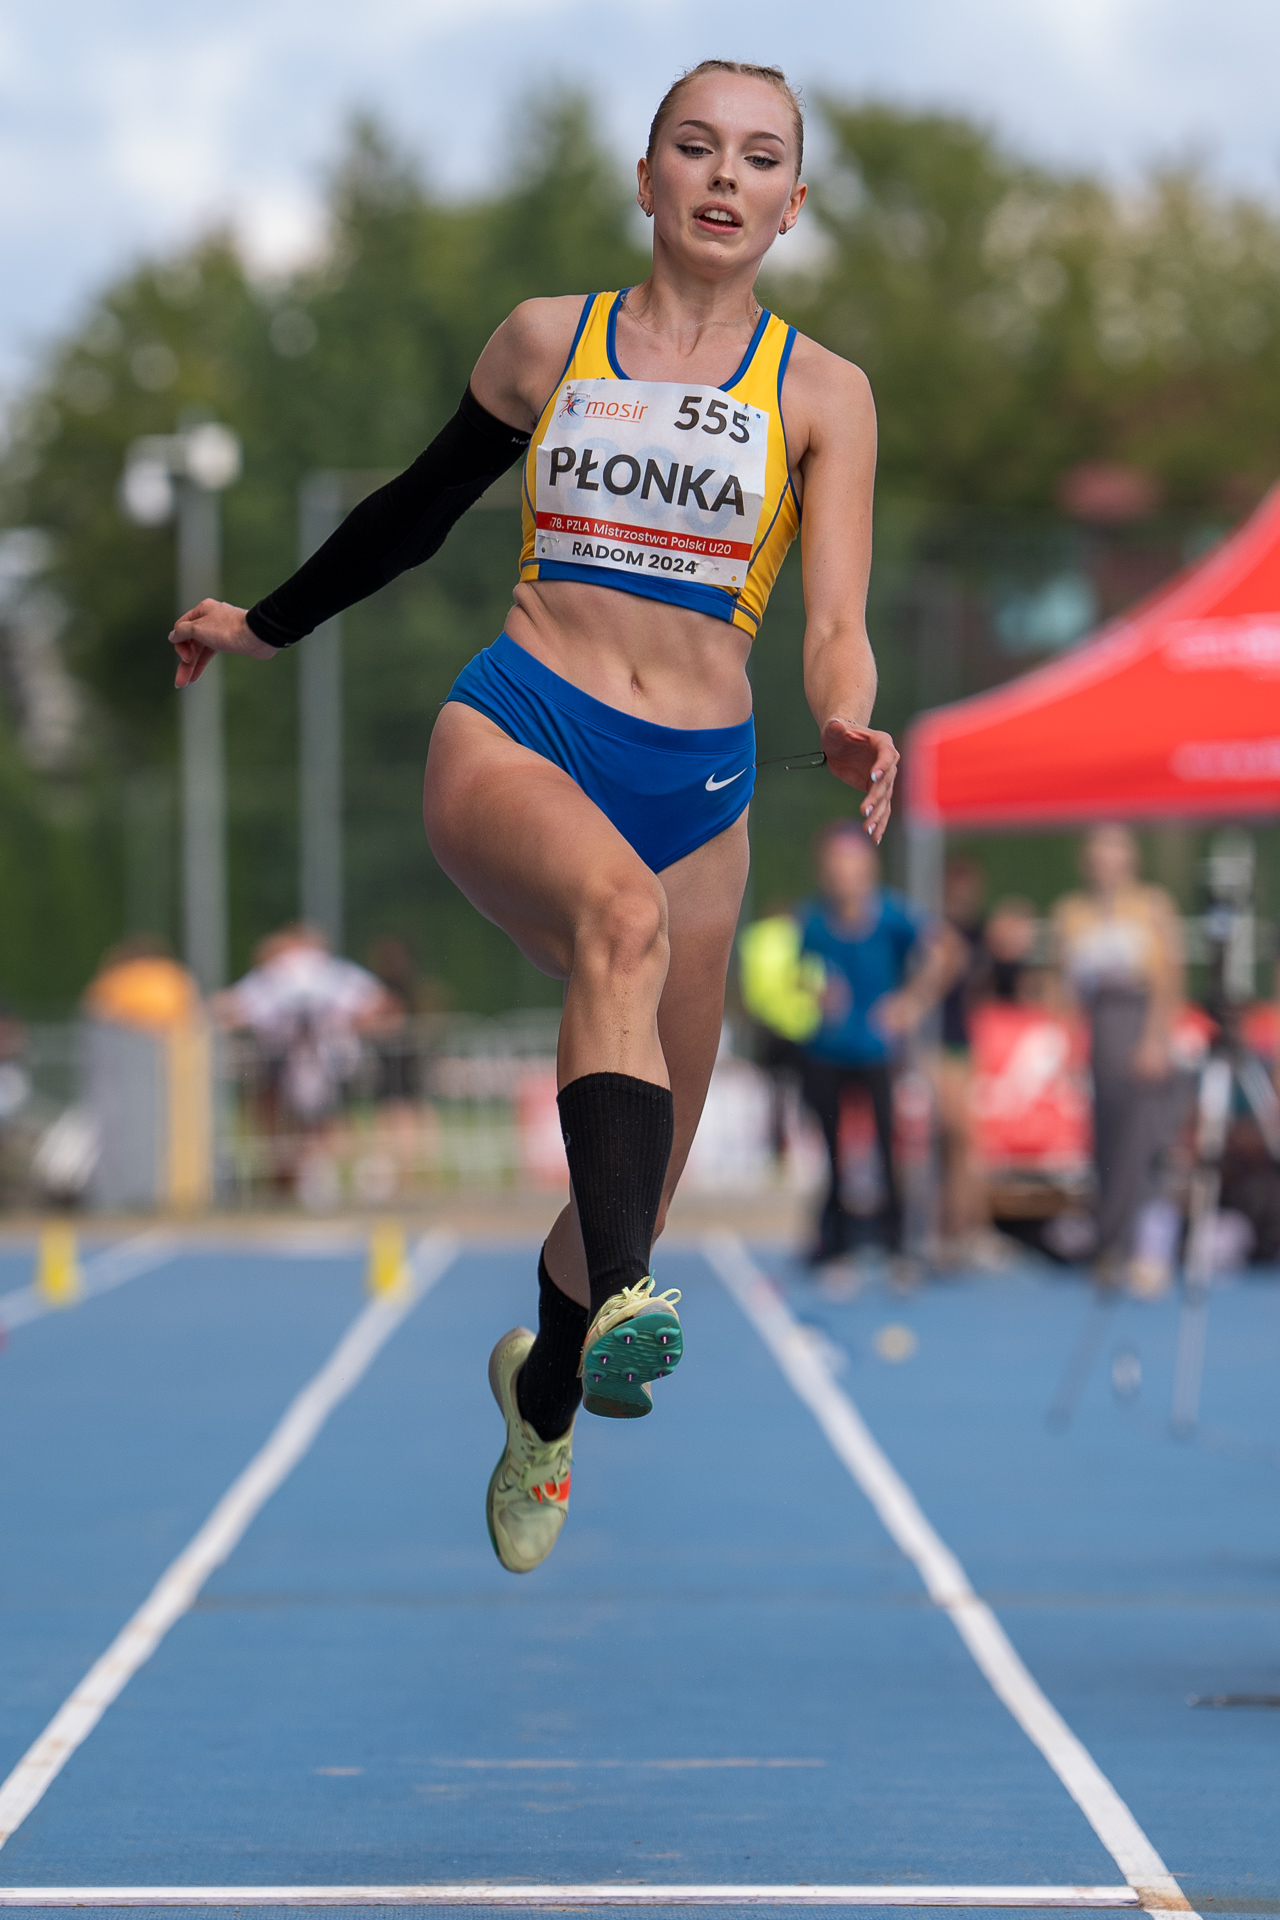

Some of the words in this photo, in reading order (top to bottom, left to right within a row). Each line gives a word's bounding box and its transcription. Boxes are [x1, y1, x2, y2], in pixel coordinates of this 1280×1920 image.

[585, 401, 649, 420] mosir
[673, 395, 750, 444] 555
[548, 446, 746, 516] PŁONKA
[551, 517, 565, 529] 78.
[566, 520, 590, 532] PZLA
[593, 523, 668, 545] Mistrzostwa
[670, 536, 707, 552] Polski
[708, 542, 732, 555] U20
[572, 541, 645, 566] RADOM
[647, 554, 697, 575] 2024
